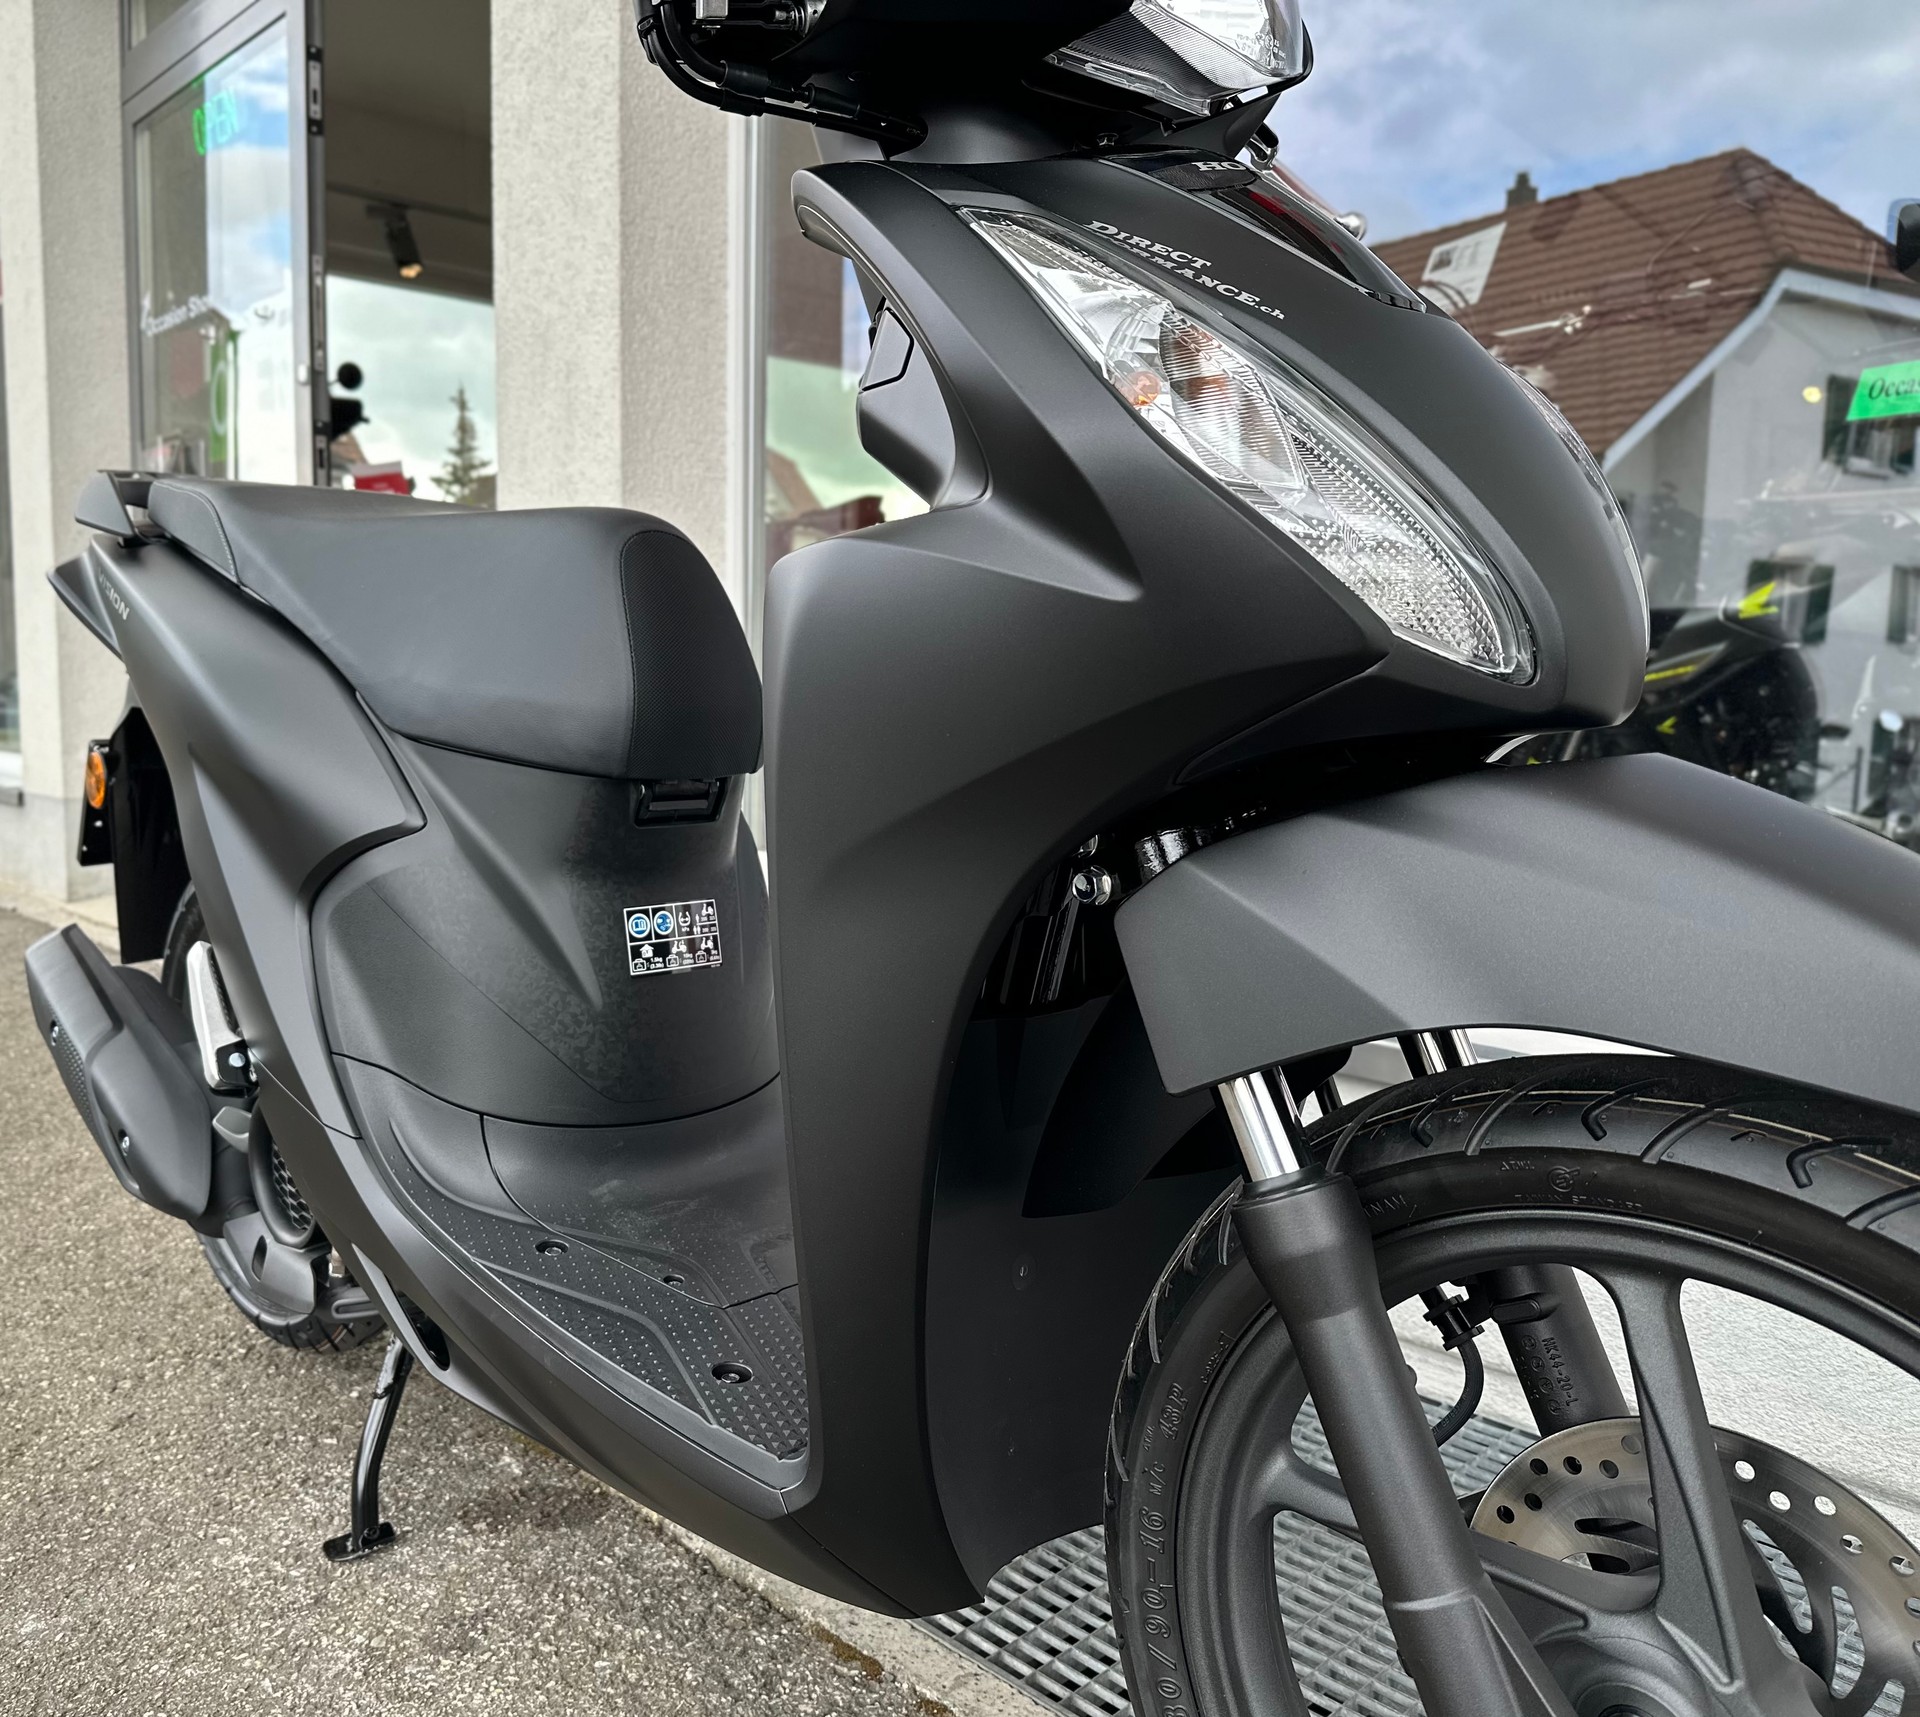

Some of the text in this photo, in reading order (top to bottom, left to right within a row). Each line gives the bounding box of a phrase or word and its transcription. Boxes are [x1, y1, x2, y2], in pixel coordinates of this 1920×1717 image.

[1191, 161, 1247, 171] HO
[1083, 220, 1212, 269] DIRECT
[1868, 377, 1920, 400] Occa
[1159, 1382, 1189, 1441] 43P
